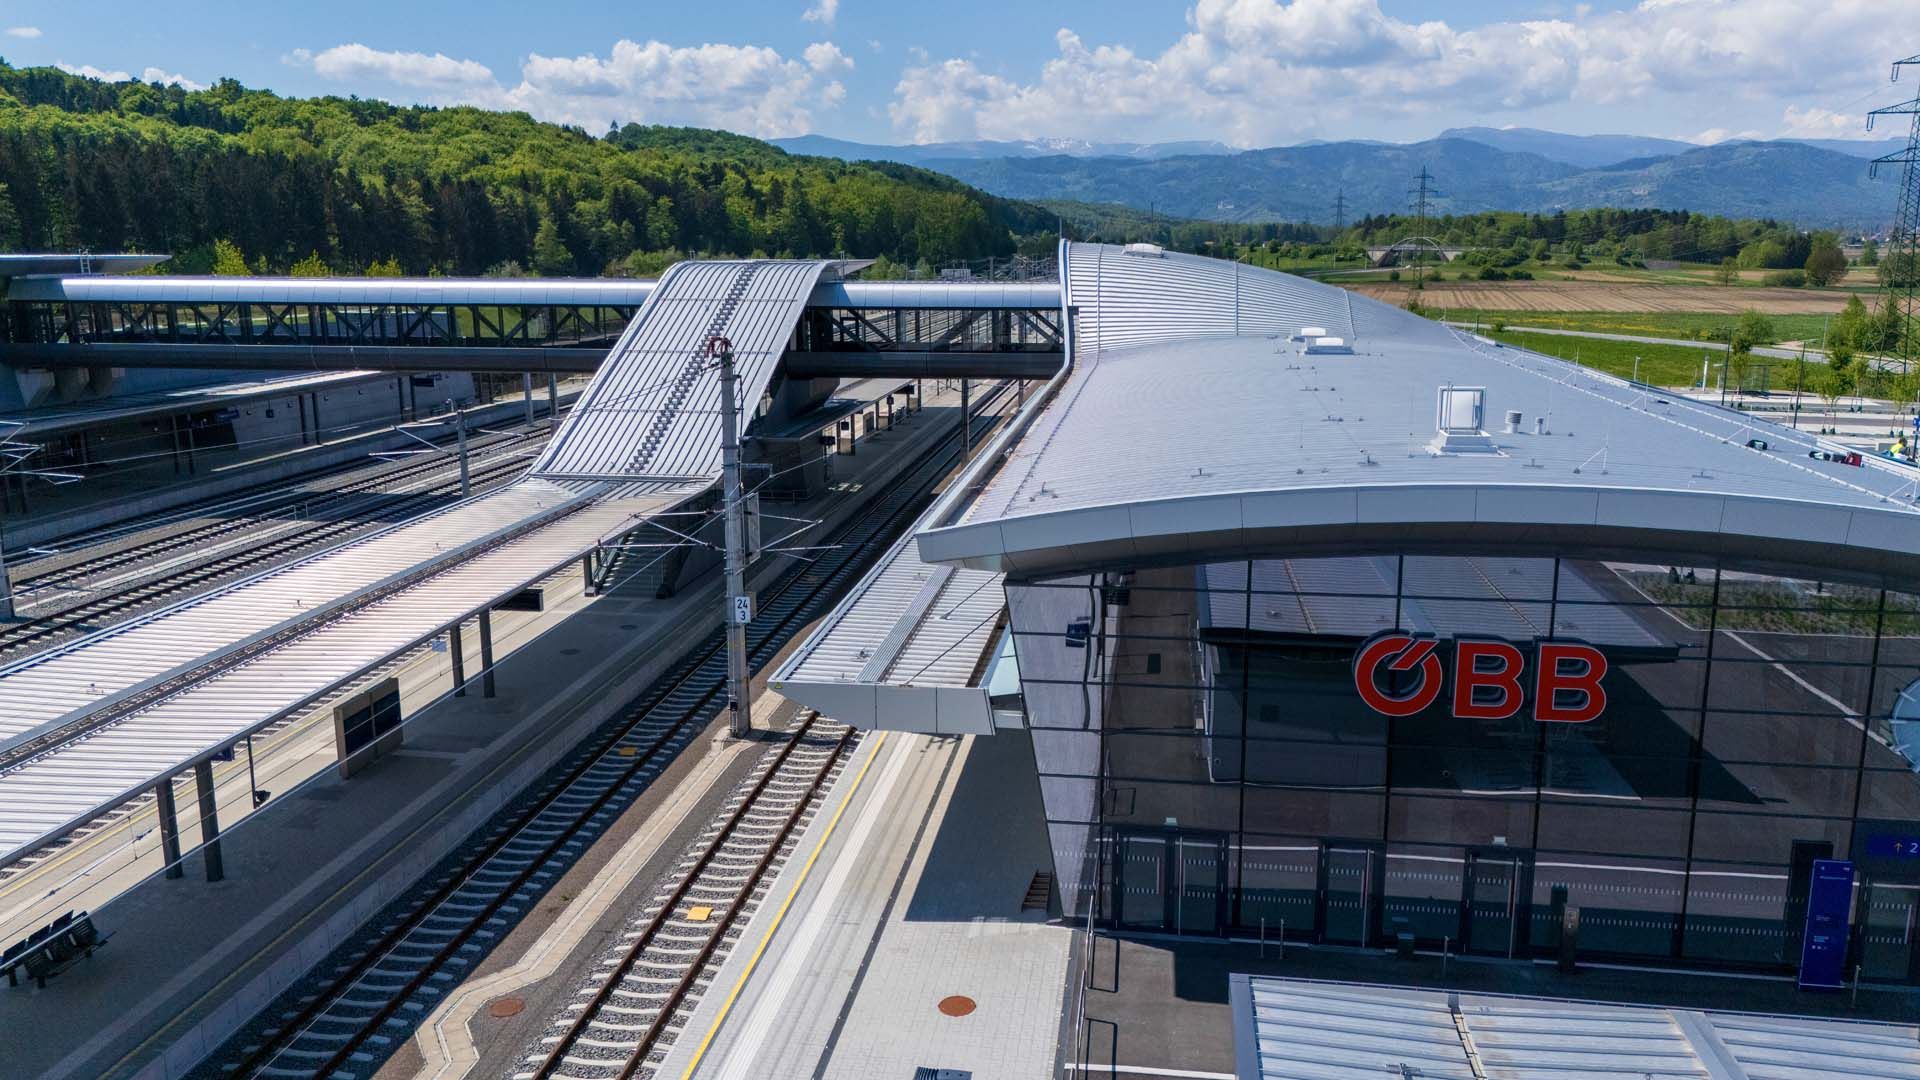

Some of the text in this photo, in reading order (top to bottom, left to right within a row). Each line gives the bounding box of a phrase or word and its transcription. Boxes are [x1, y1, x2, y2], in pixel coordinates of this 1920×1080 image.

[737, 599, 748, 609] 24
[740, 610, 746, 621] 3
[1355, 636, 1608, 723] ÖBB
[1909, 842, 1919, 854] 2
